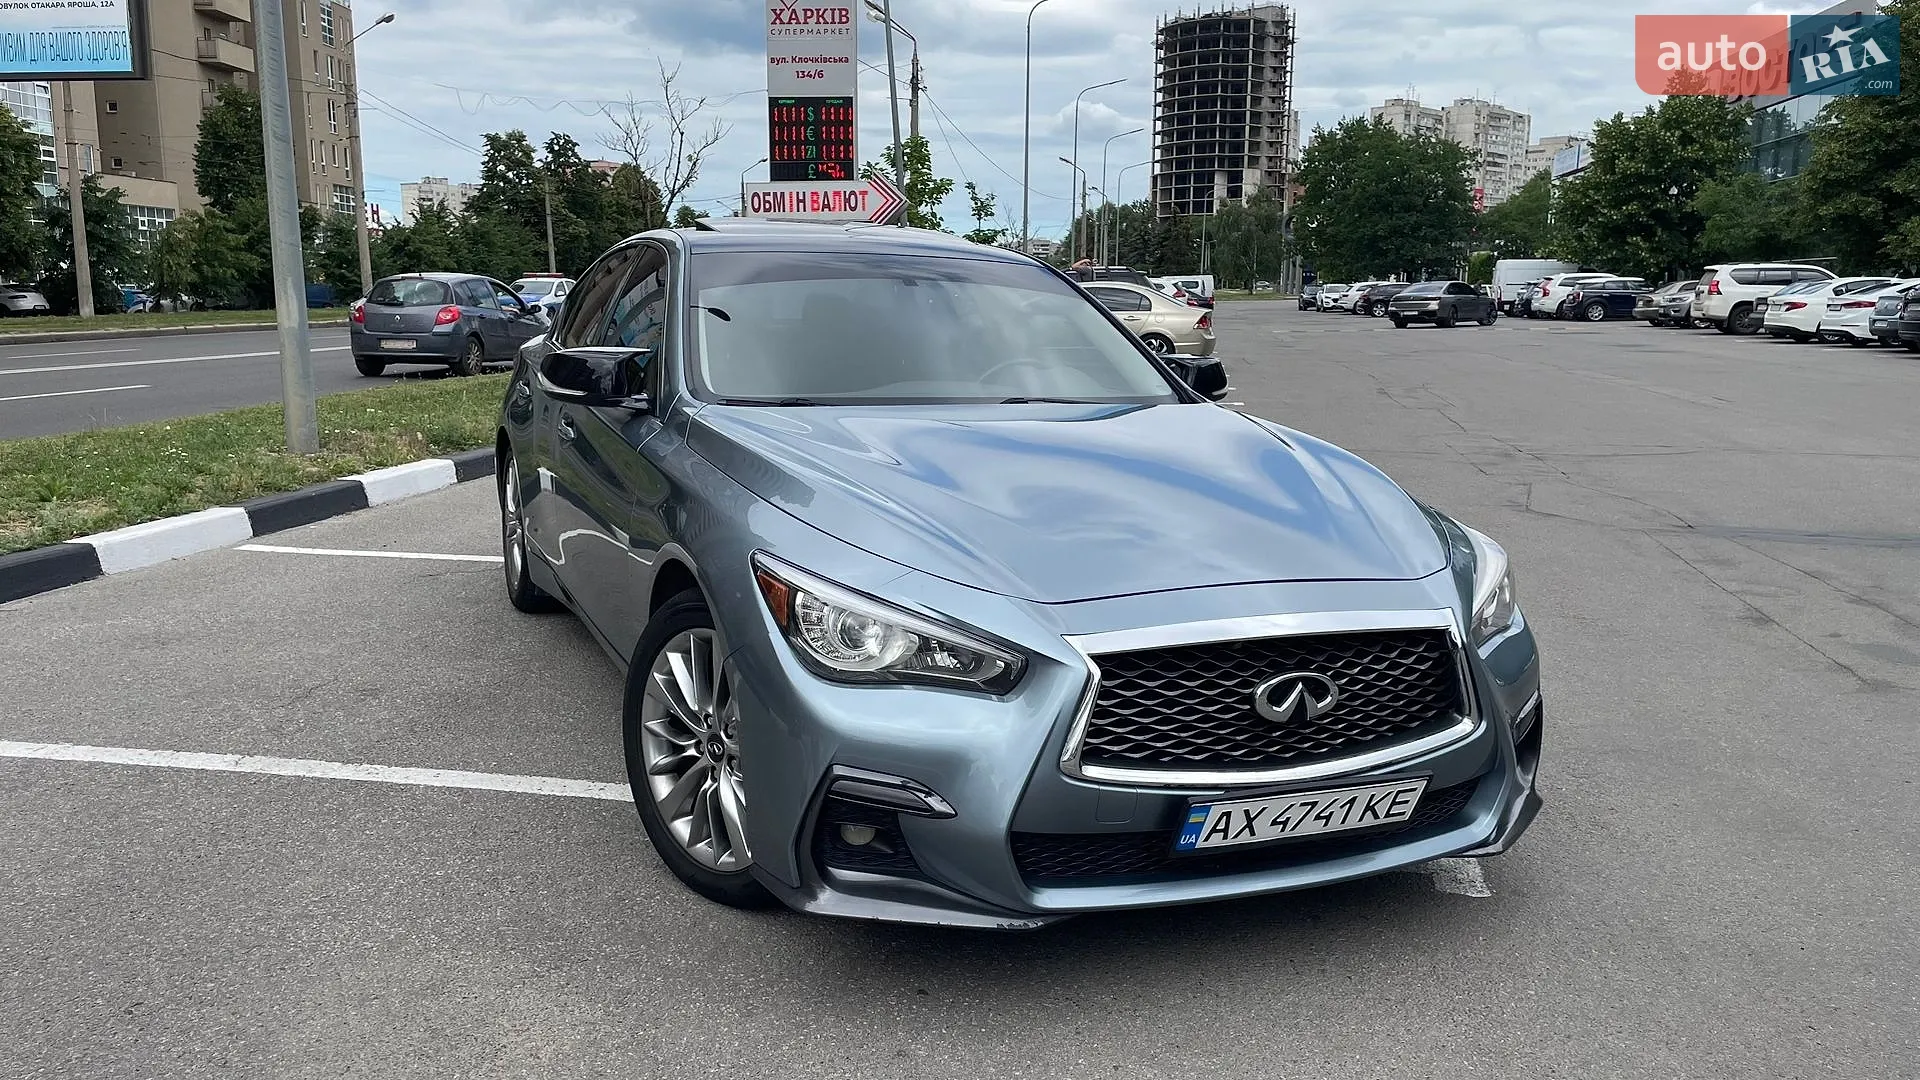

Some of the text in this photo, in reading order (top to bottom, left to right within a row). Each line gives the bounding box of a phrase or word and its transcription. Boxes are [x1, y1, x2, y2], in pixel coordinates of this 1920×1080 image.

[67, 1, 98, 9] ЯРОША,
[770, 8, 850, 25] ХАРКІВ
[29, 32, 47, 64] ДЛЯ
[48, 31, 83, 62] ВАШОГО
[770, 54, 849, 65] вул. Клочківська
[751, 190, 868, 213] ОБМІН ВАЛЮТ
[1202, 787, 1418, 842] AX 4741 KE
[1180, 834, 1196, 845] UA
